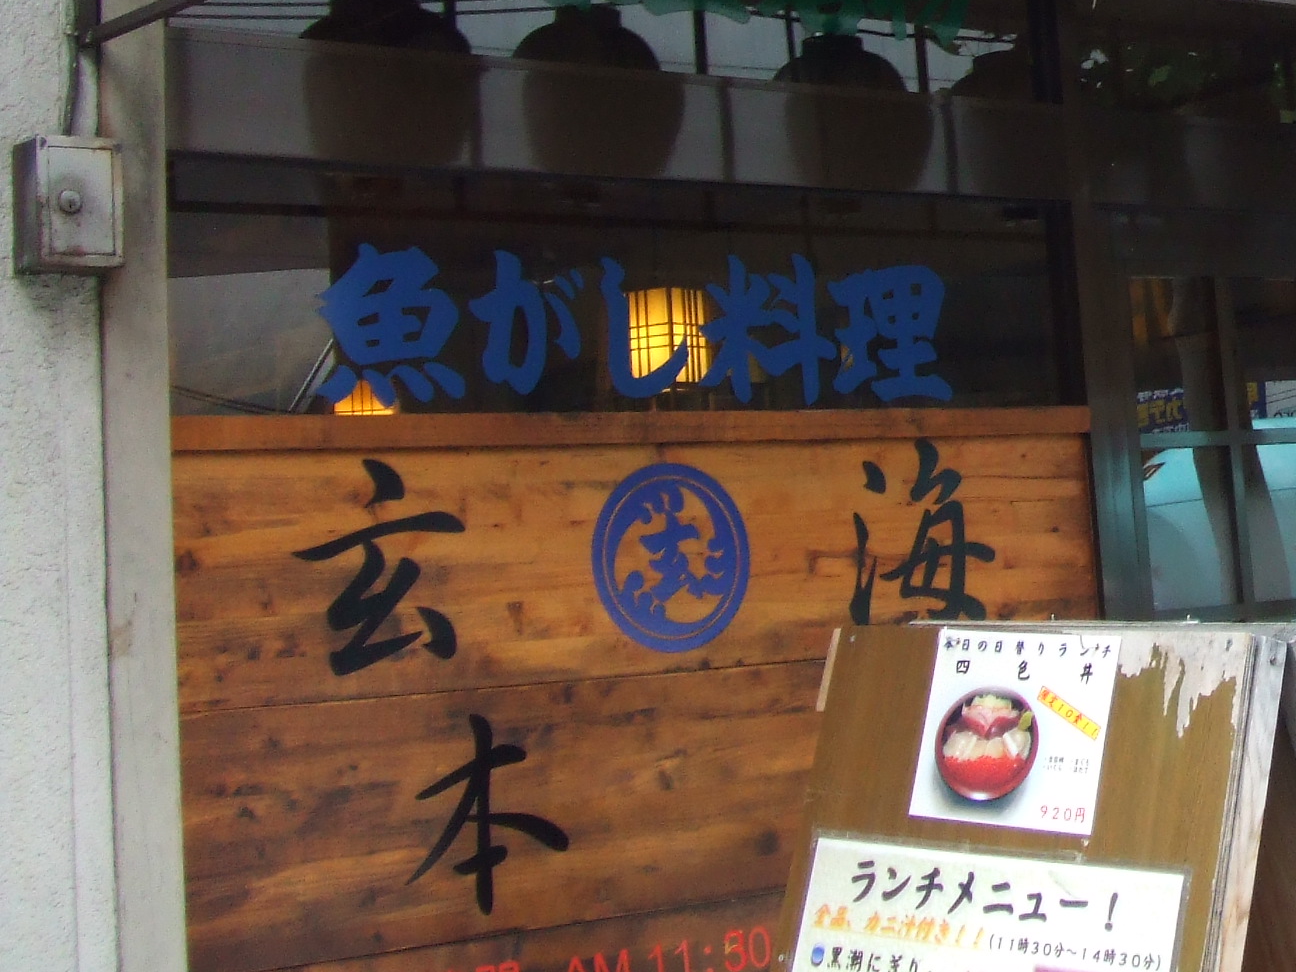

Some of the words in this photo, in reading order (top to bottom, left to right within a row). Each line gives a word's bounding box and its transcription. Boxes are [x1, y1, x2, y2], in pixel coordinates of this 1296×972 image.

[315, 243, 953, 404] 魚がし料理
[293, 459, 466, 676] 玄
[852, 439, 998, 625] 海
[956, 660, 1094, 684] 四色丼
[406, 714, 569, 916] 本
[1040, 804, 1086, 824] 920円
